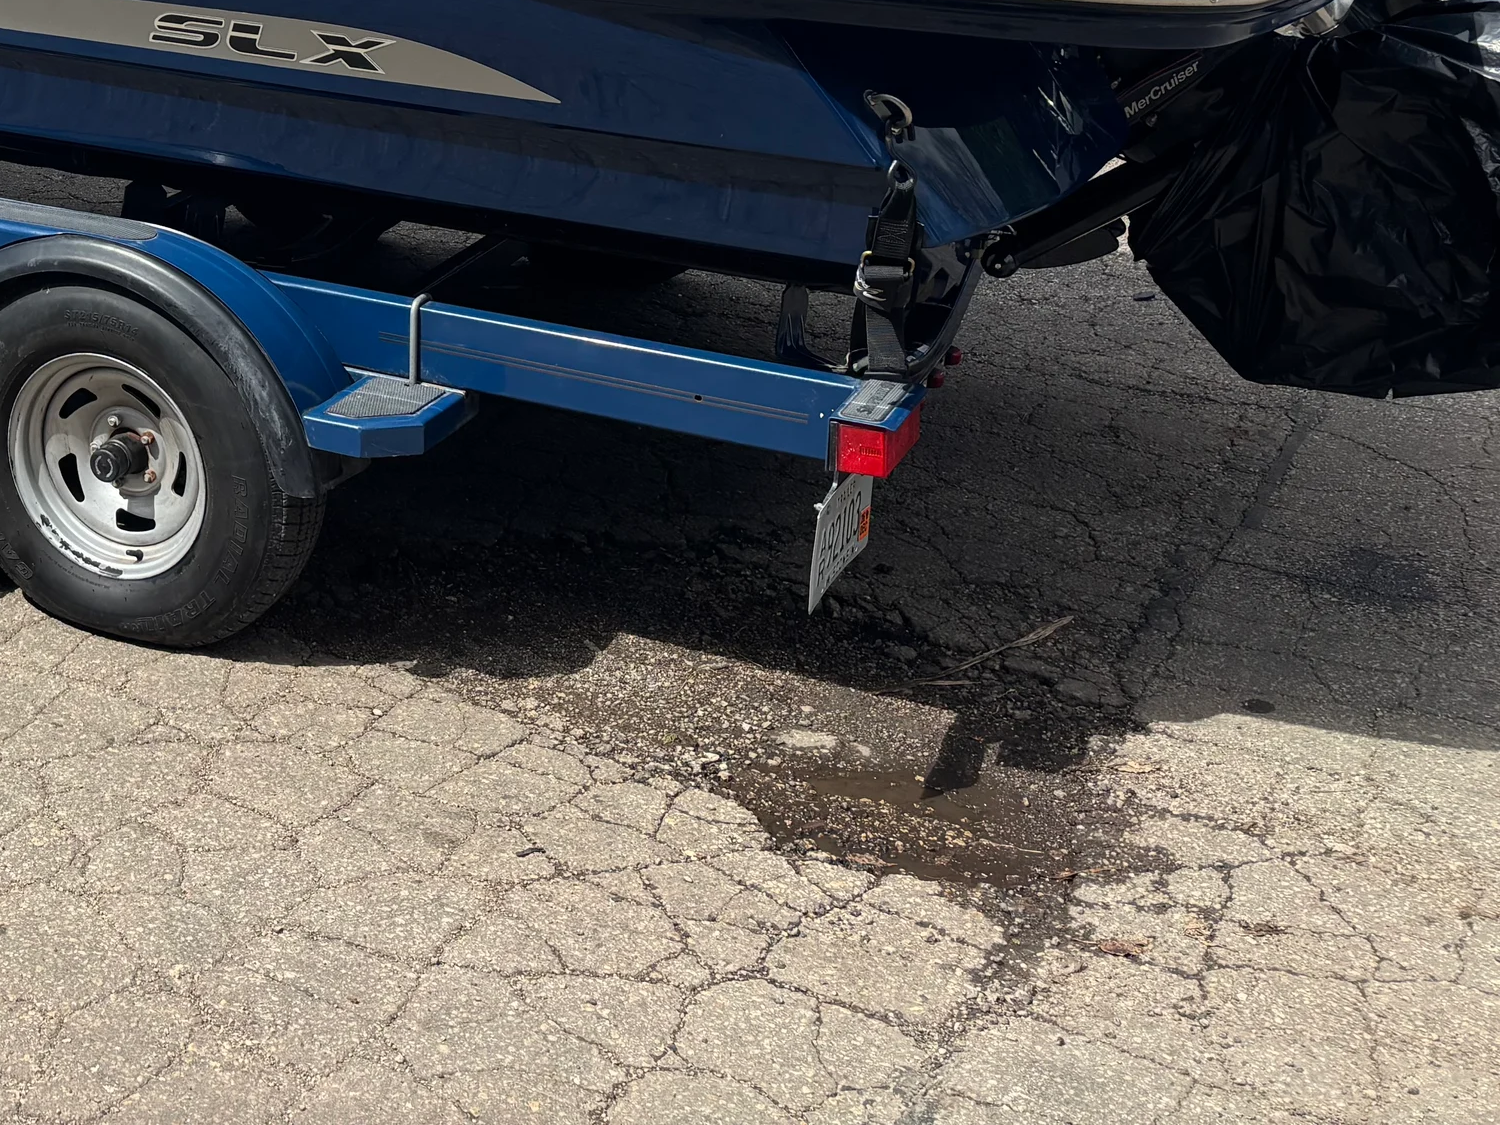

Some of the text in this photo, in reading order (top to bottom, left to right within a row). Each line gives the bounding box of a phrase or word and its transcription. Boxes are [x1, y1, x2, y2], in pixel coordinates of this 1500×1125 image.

[148, 12, 397, 75] SLX
[1123, 60, 1200, 119] MerCruiser
[136, 474, 250, 632] RADIAL TRAIL
